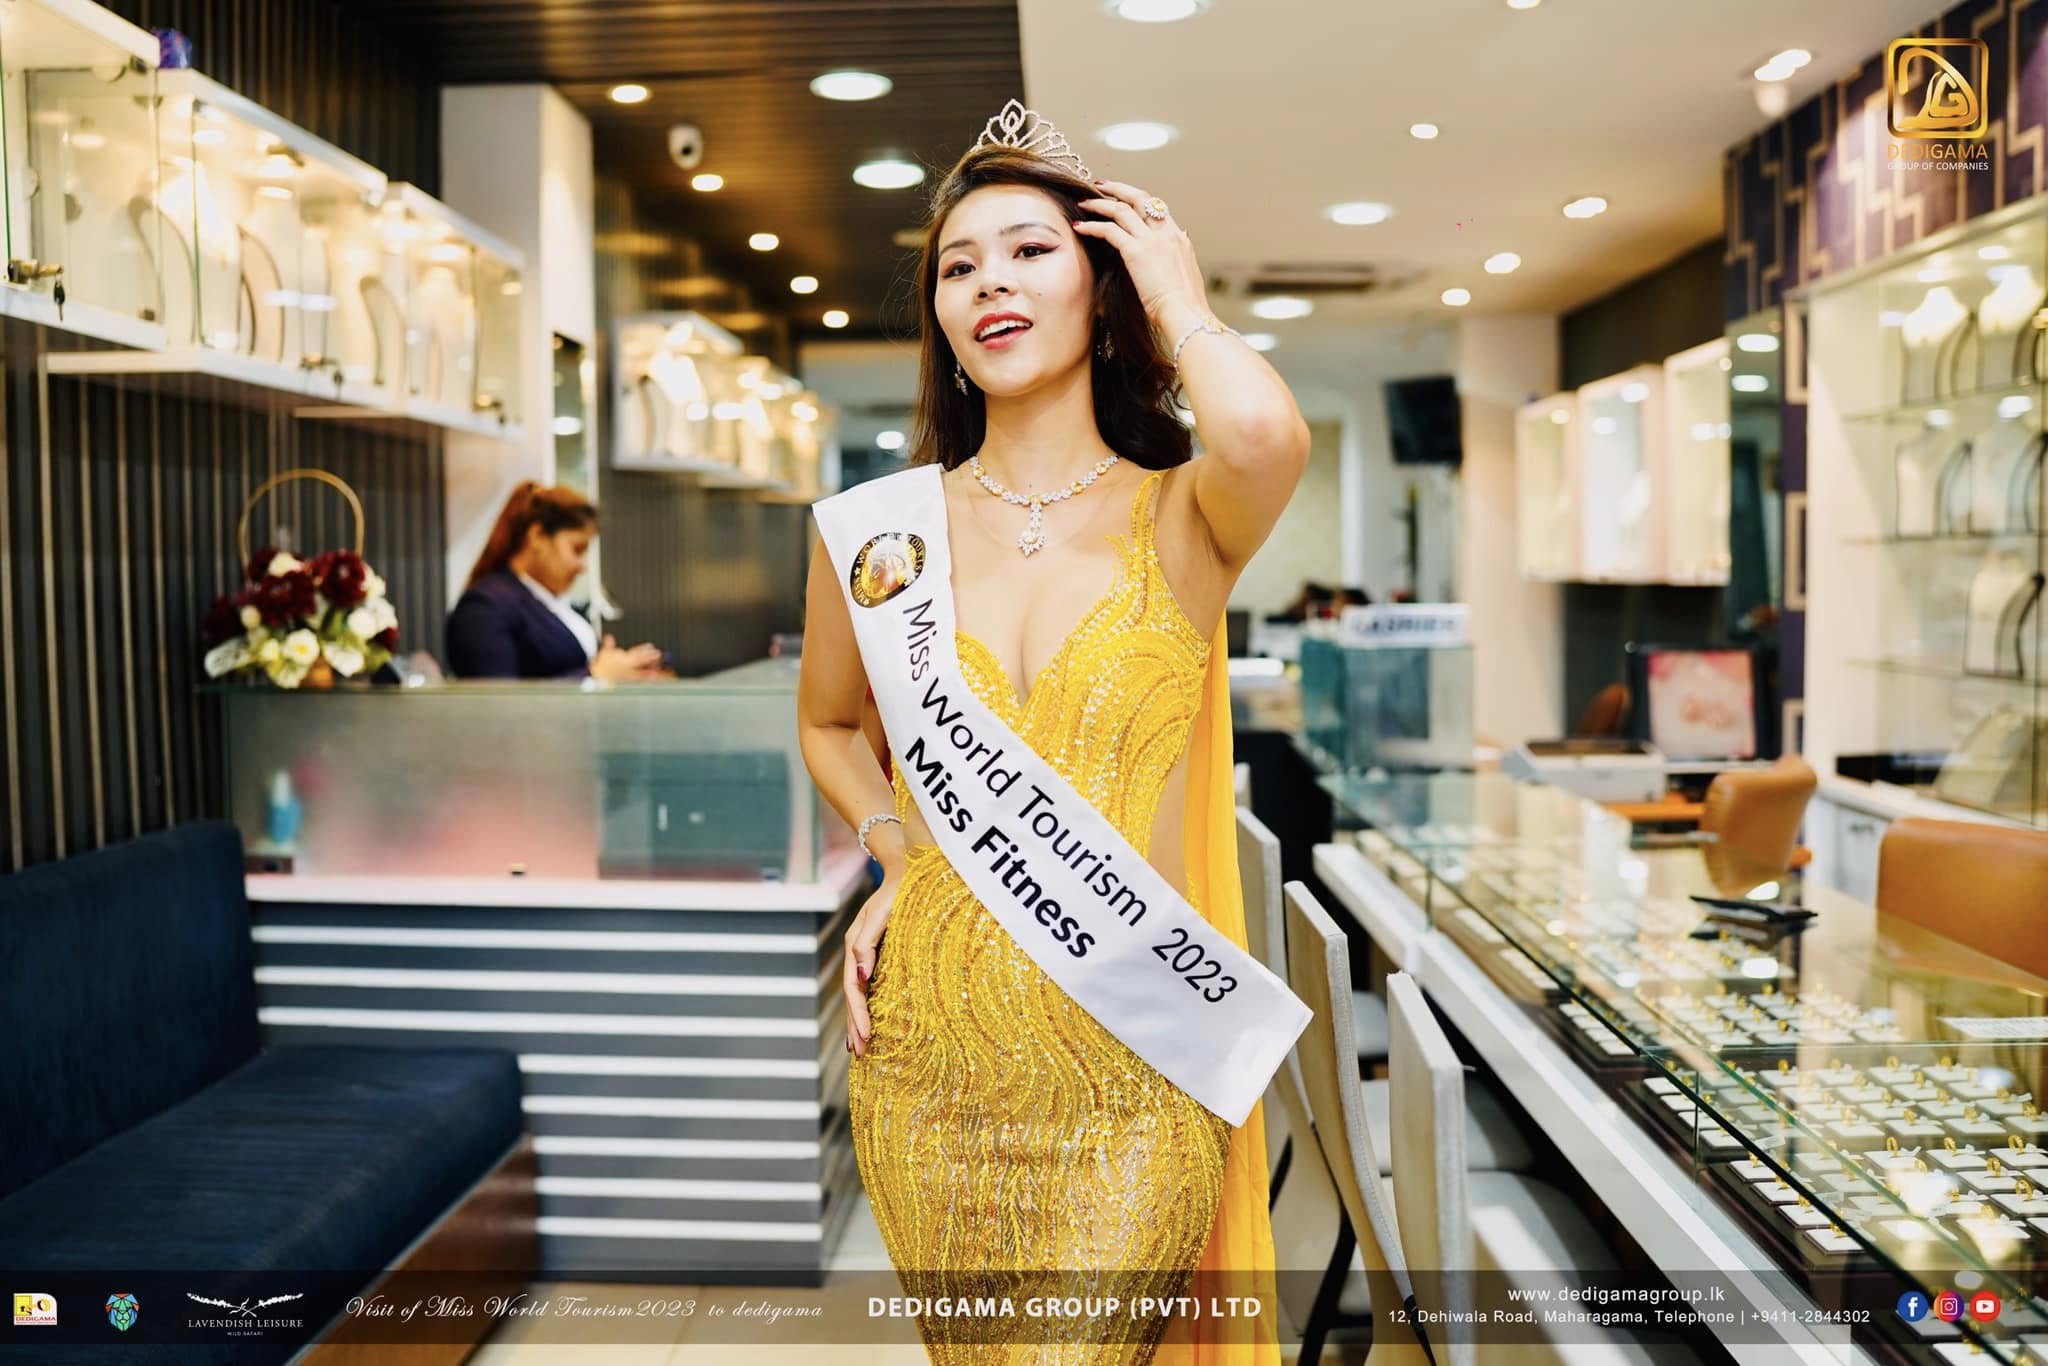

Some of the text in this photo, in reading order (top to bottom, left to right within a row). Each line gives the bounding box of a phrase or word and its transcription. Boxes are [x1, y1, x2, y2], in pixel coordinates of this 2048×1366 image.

[903, 599, 1238, 1004] Miss World Tourism 2023
[906, 737, 1096, 959] Miss Fitness
